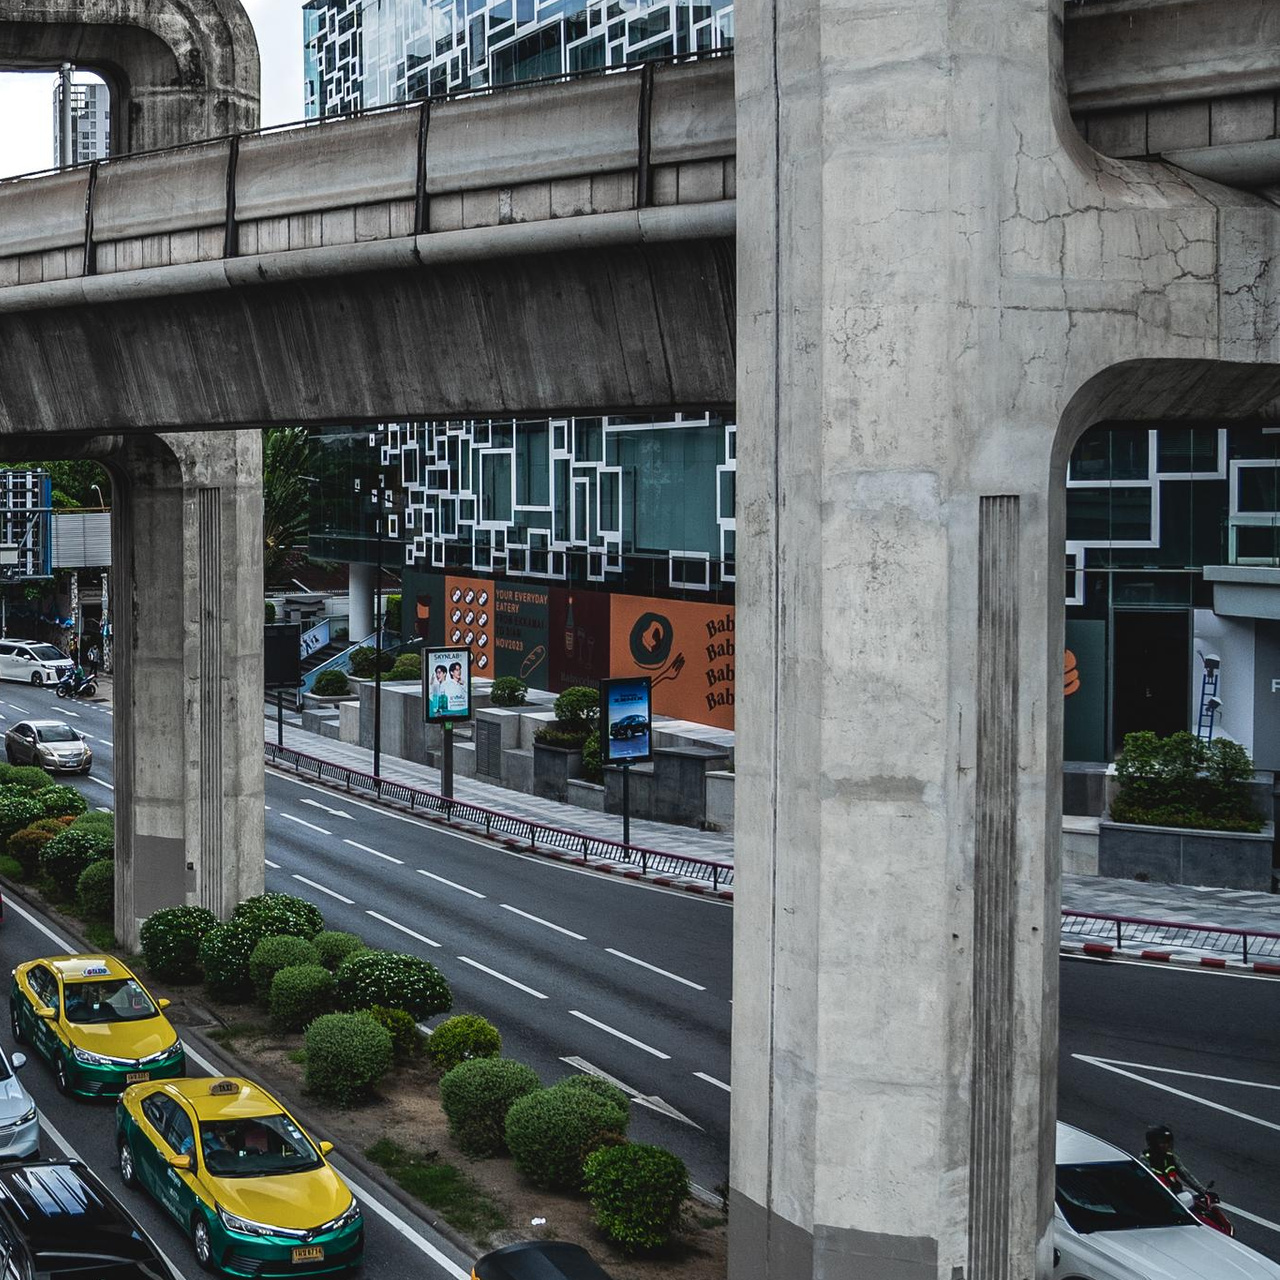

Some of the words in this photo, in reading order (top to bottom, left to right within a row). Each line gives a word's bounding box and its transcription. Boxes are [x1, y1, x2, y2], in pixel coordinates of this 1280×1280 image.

[496, 589, 513, 601] YOUR
[515, 591, 548, 604] EVERYDAY
[496, 601, 520, 614] EATERY
